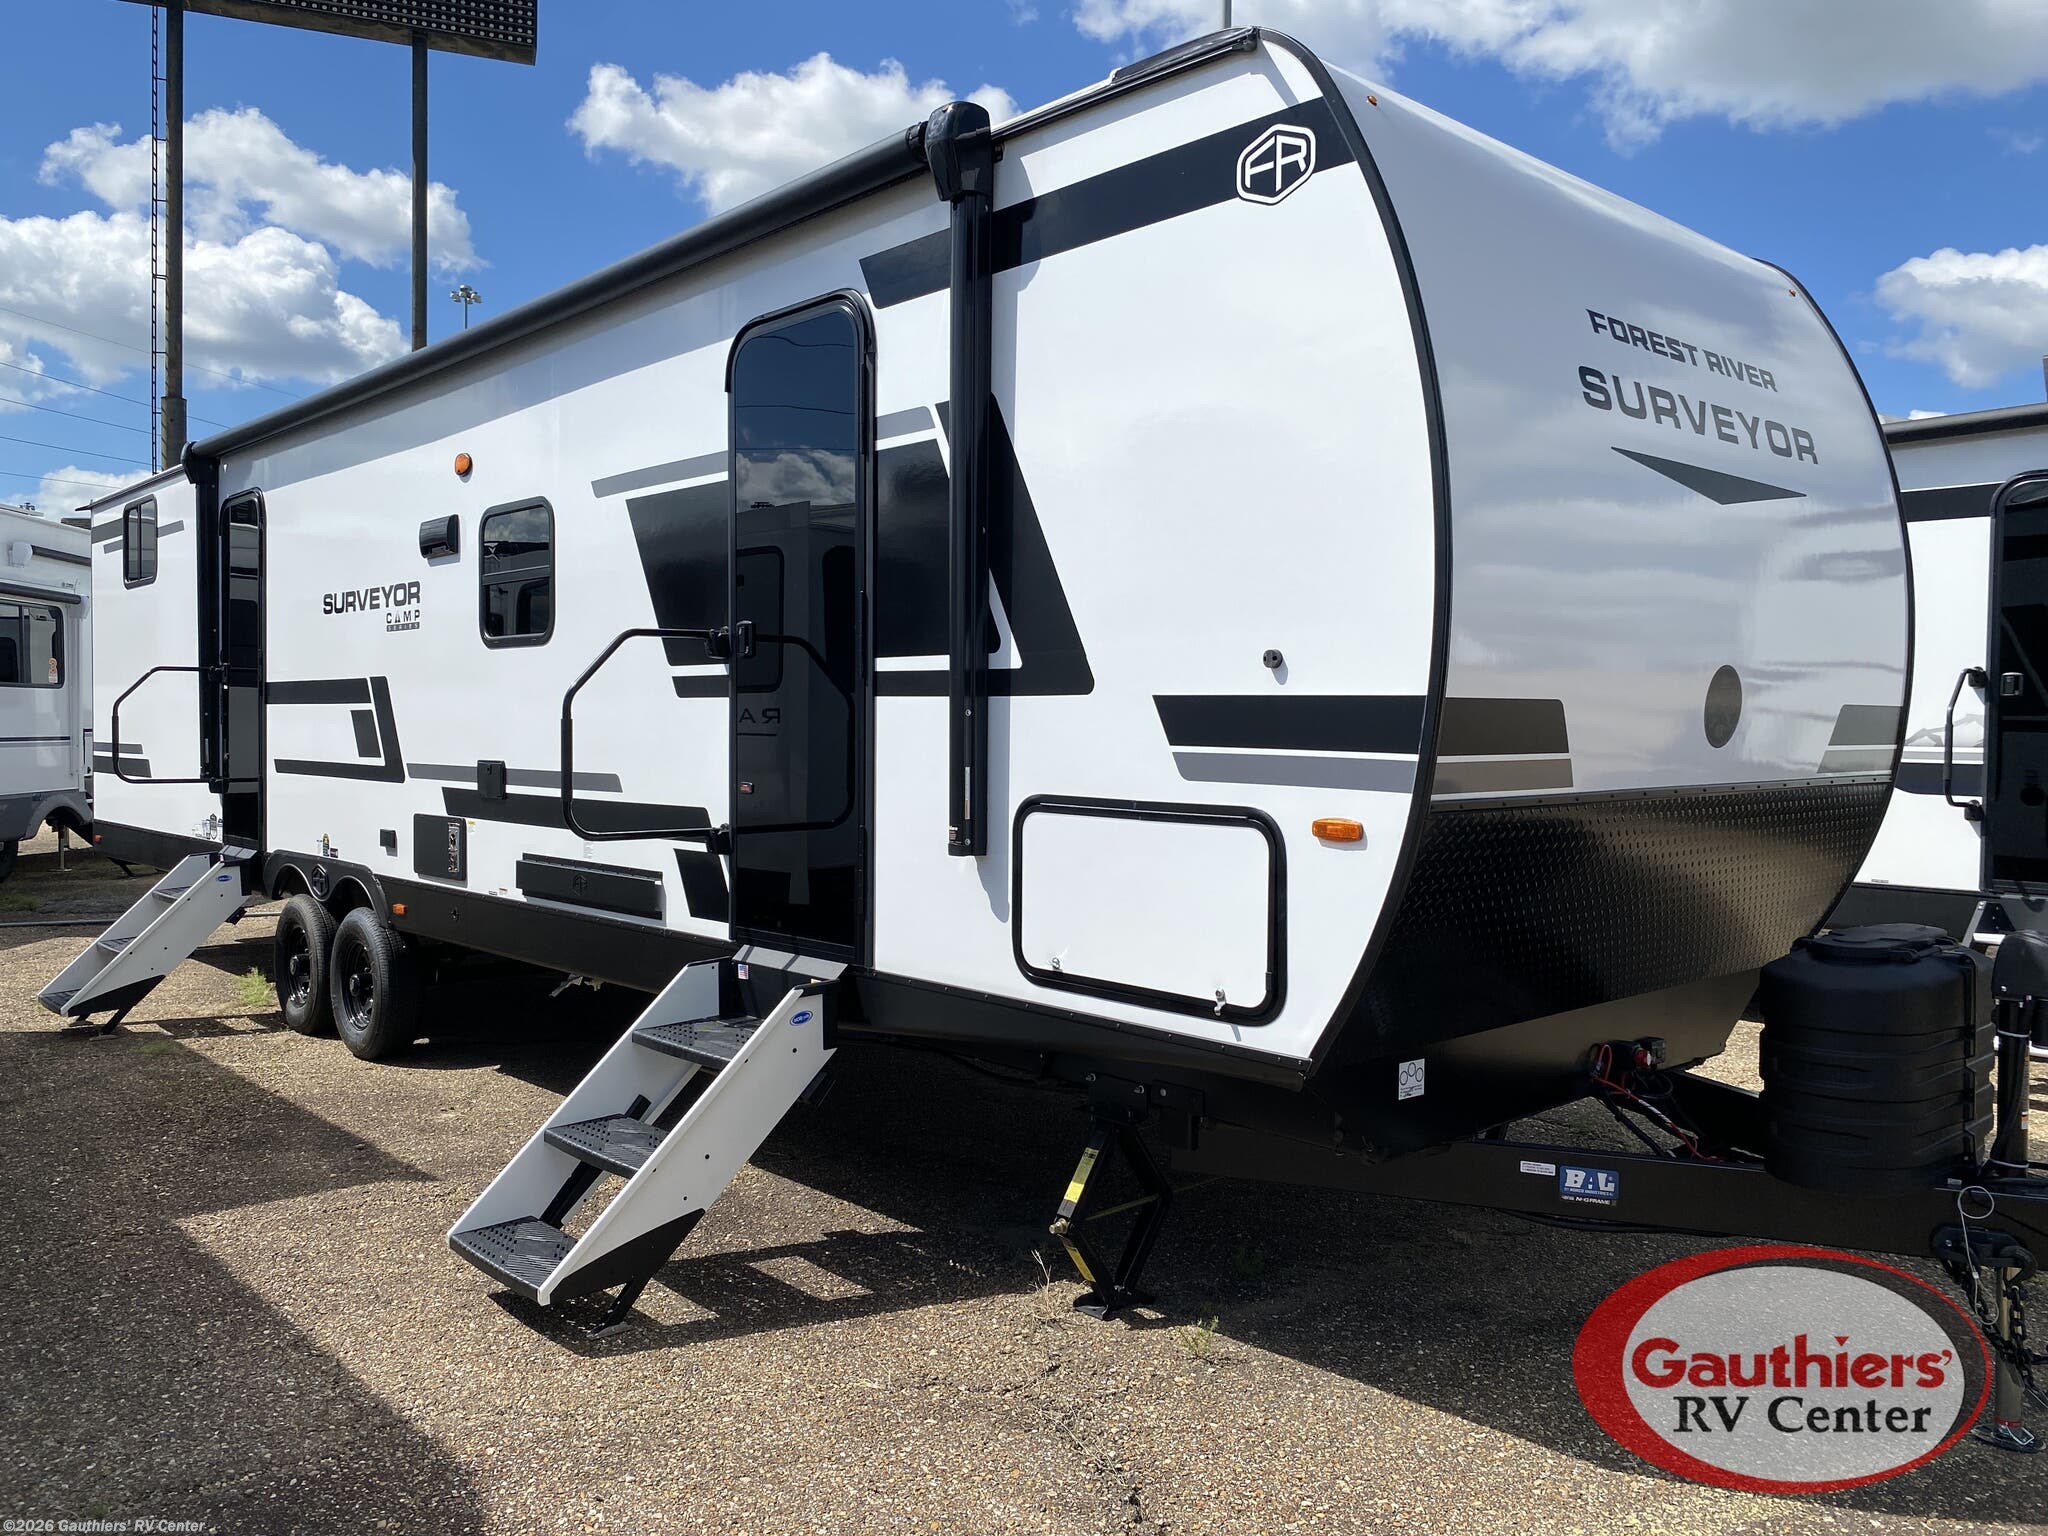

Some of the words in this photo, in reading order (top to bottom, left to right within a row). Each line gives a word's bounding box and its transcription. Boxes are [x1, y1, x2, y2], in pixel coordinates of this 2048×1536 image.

[1586, 309, 1698, 367] FOREST
[1702, 349, 1778, 393] RIVER
[1578, 365, 1819, 465] SURVEYOR
[323, 580, 421, 615] SURVEYOR
[386, 609, 421, 624] CAMP
[387, 622, 420, 632] SERIES
[1564, 1168, 1616, 1192] BAL
